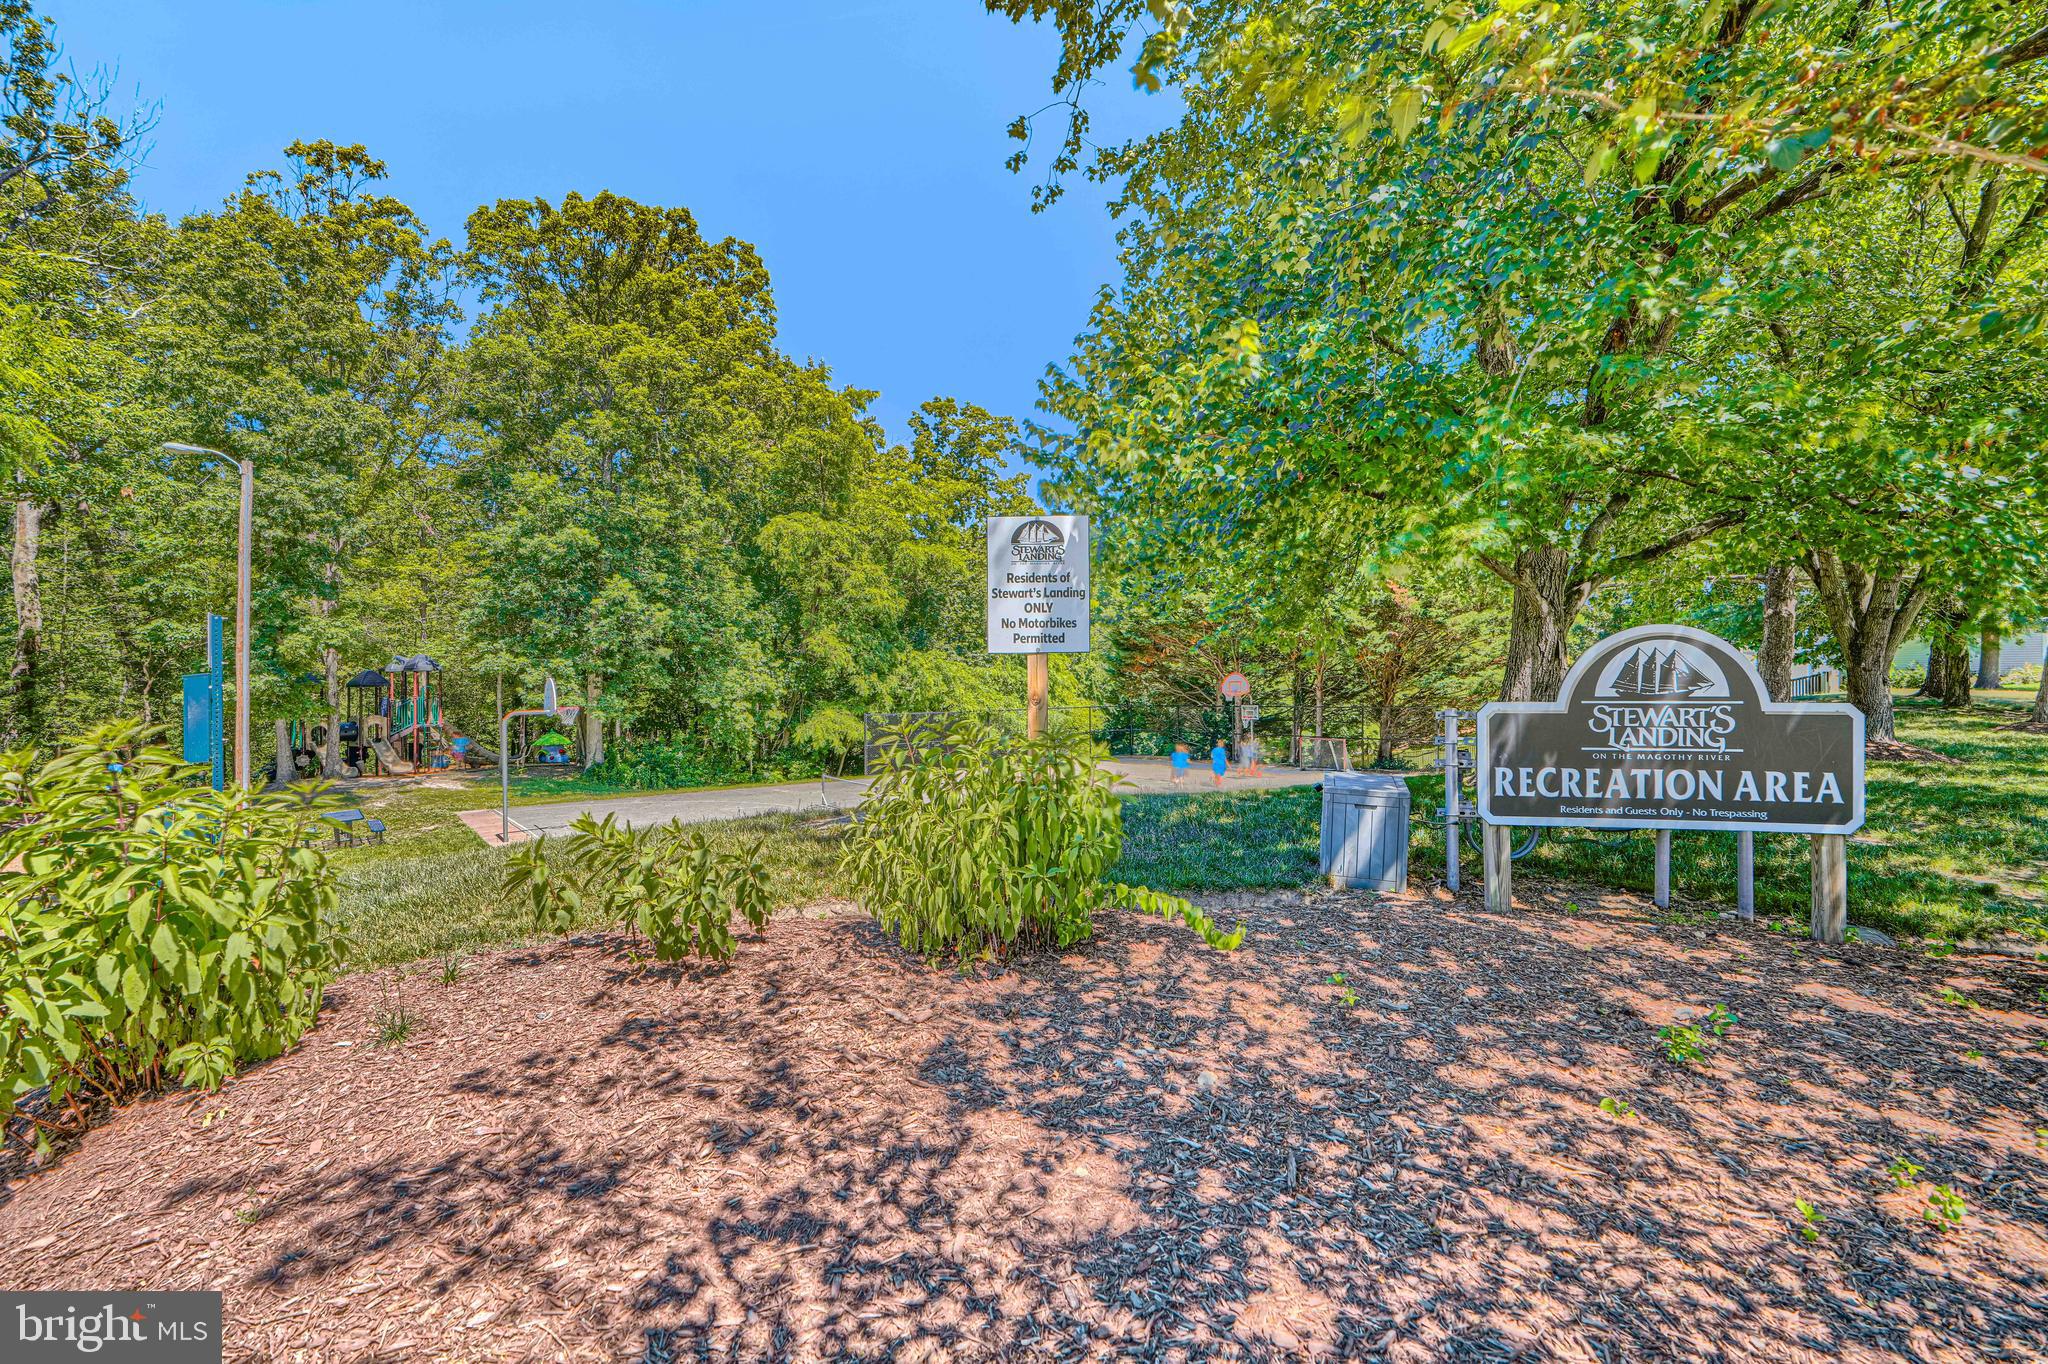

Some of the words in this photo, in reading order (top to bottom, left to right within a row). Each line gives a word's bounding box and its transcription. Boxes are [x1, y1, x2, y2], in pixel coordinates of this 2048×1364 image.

[1012, 545, 1065, 556] STEWART'S
[1019, 553, 1063, 562] LANDING
[1006, 572, 1057, 583] Residents
[1060, 572, 1070, 583] of
[991, 588, 1041, 599] Stewart's
[1043, 587, 1086, 600] Landing
[1024, 603, 1053, 614] ONLY
[1001, 618, 1016, 629] No
[1018, 618, 1077, 629] Motorbikes
[1013, 633, 1065, 644] Permitted
[1588, 705, 1736, 734] STEWART'S
[1608, 727, 1726, 754] LANDING
[1636, 753, 1693, 761] MAGOTHY
[1494, 766, 1723, 802] RECREATION
[1735, 769, 1845, 805] AREA
[1560, 805, 1603, 815] Residents
[1604, 806, 1623, 815] and
[1625, 806, 1657, 816] Guests
[1660, 807, 1684, 818] Only
[1692, 808, 1708, 817] No
[1709, 809, 1768, 820] Trespassing
